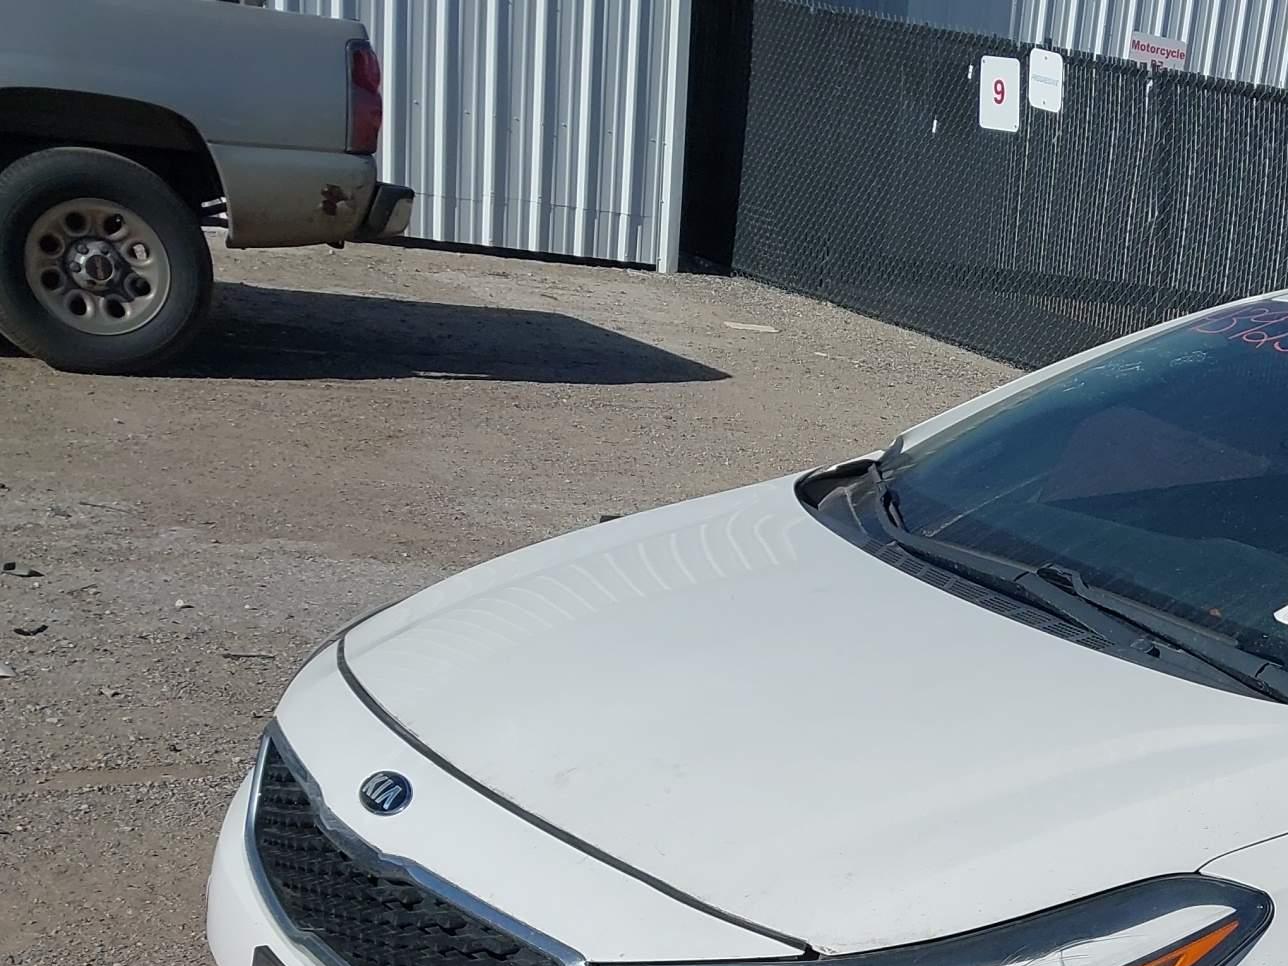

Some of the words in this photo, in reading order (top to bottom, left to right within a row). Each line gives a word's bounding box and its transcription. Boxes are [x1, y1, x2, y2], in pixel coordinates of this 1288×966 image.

[1131, 40, 1186, 60] Motorcycle
[993, 79, 1006, 105] 9
[362, 773, 402, 810] KIA
